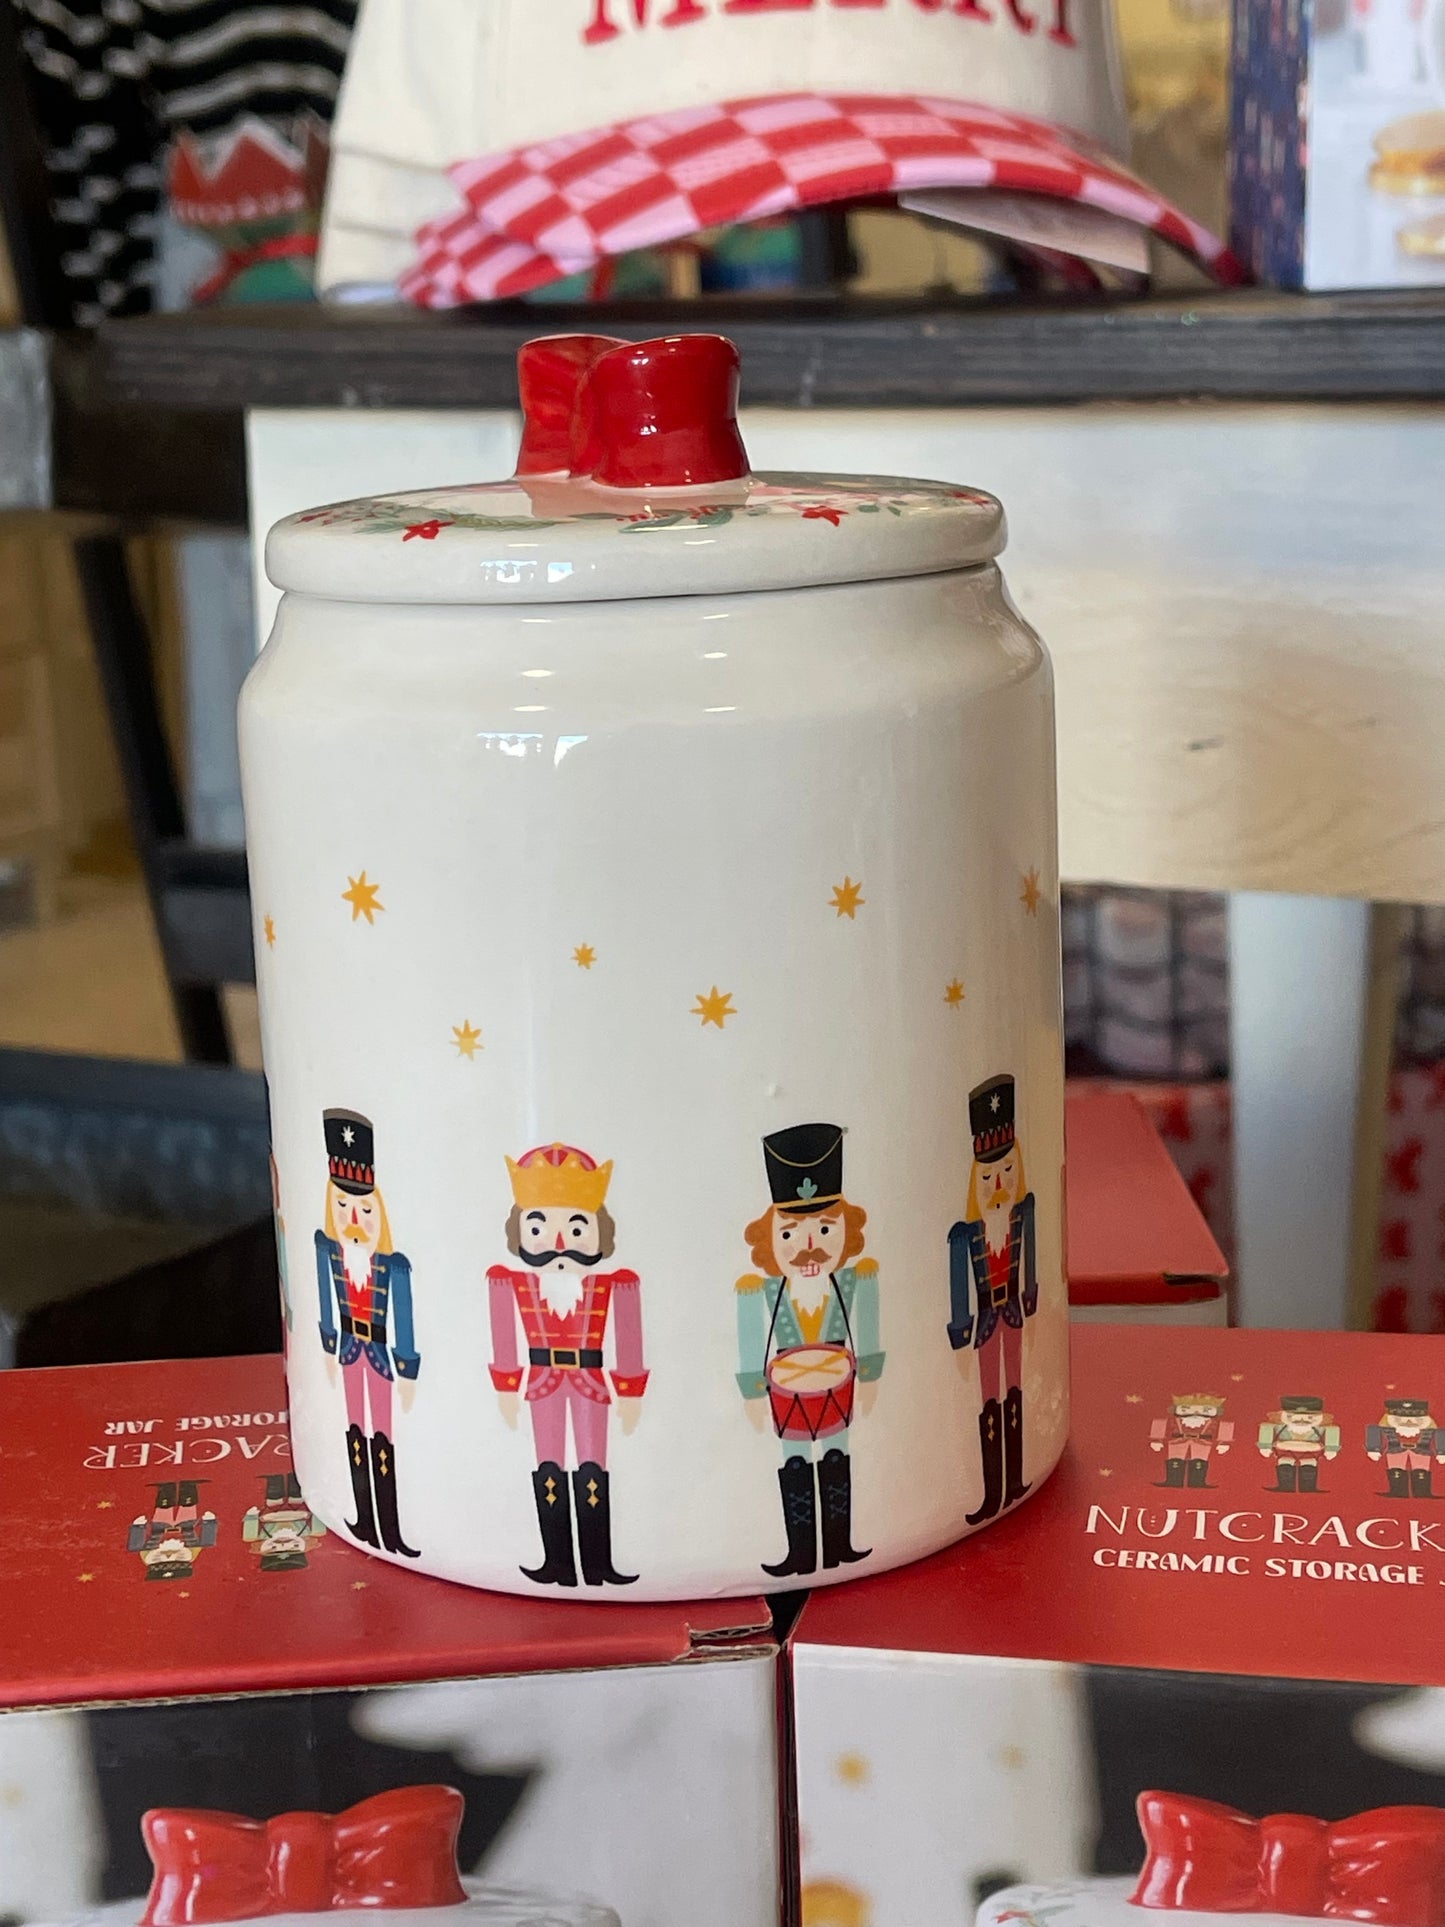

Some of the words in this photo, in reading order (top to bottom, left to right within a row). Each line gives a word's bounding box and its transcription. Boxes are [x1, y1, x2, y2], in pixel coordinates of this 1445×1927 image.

[104, 1419, 163, 1435] JAR
[1093, 1548, 1250, 1575] CERAMIC
[1264, 1558, 1425, 1585] STORAGE
